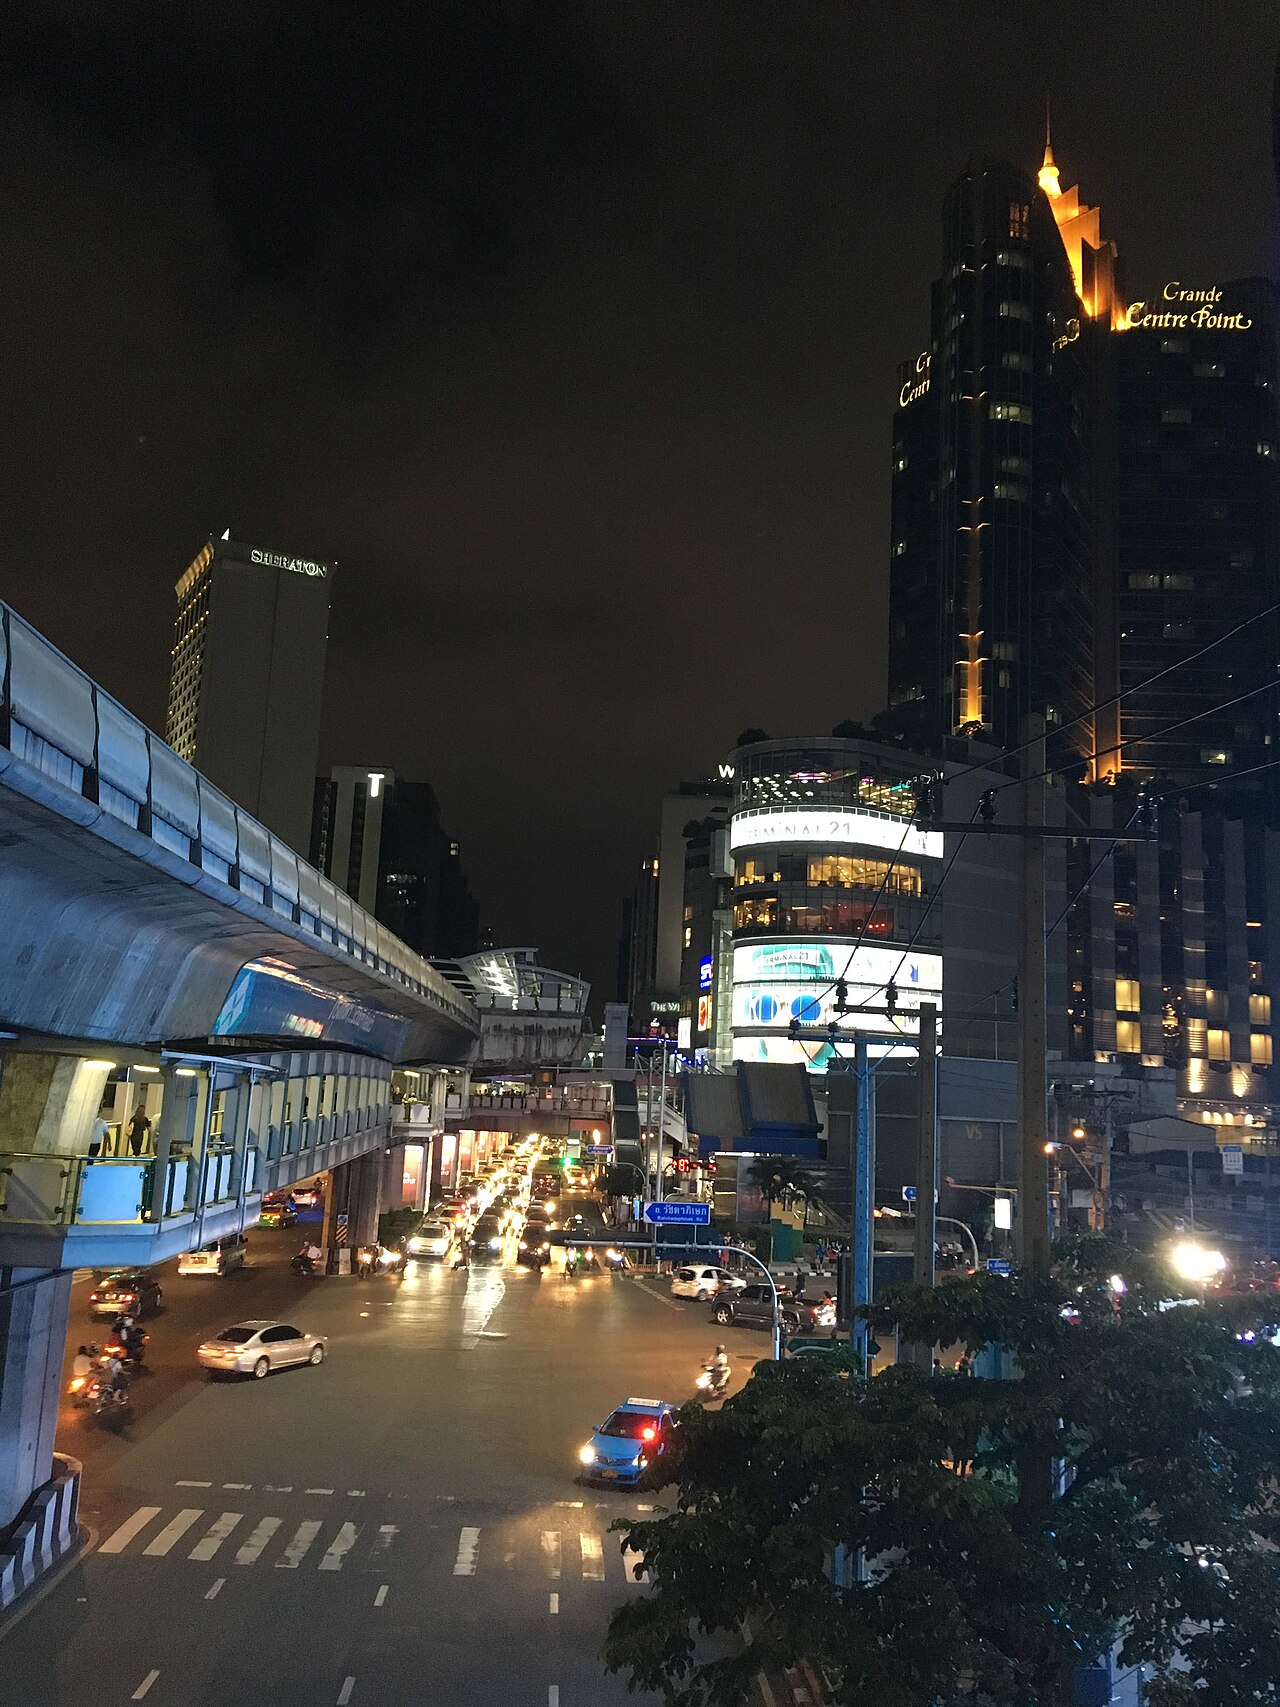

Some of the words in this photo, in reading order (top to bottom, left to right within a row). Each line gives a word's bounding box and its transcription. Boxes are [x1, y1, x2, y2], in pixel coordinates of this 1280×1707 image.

[1163, 281, 1223, 302] Grande
[1126, 301, 1188, 328] Centre
[1190, 304, 1252, 330] Point
[251, 549, 328, 578] SHERATON
